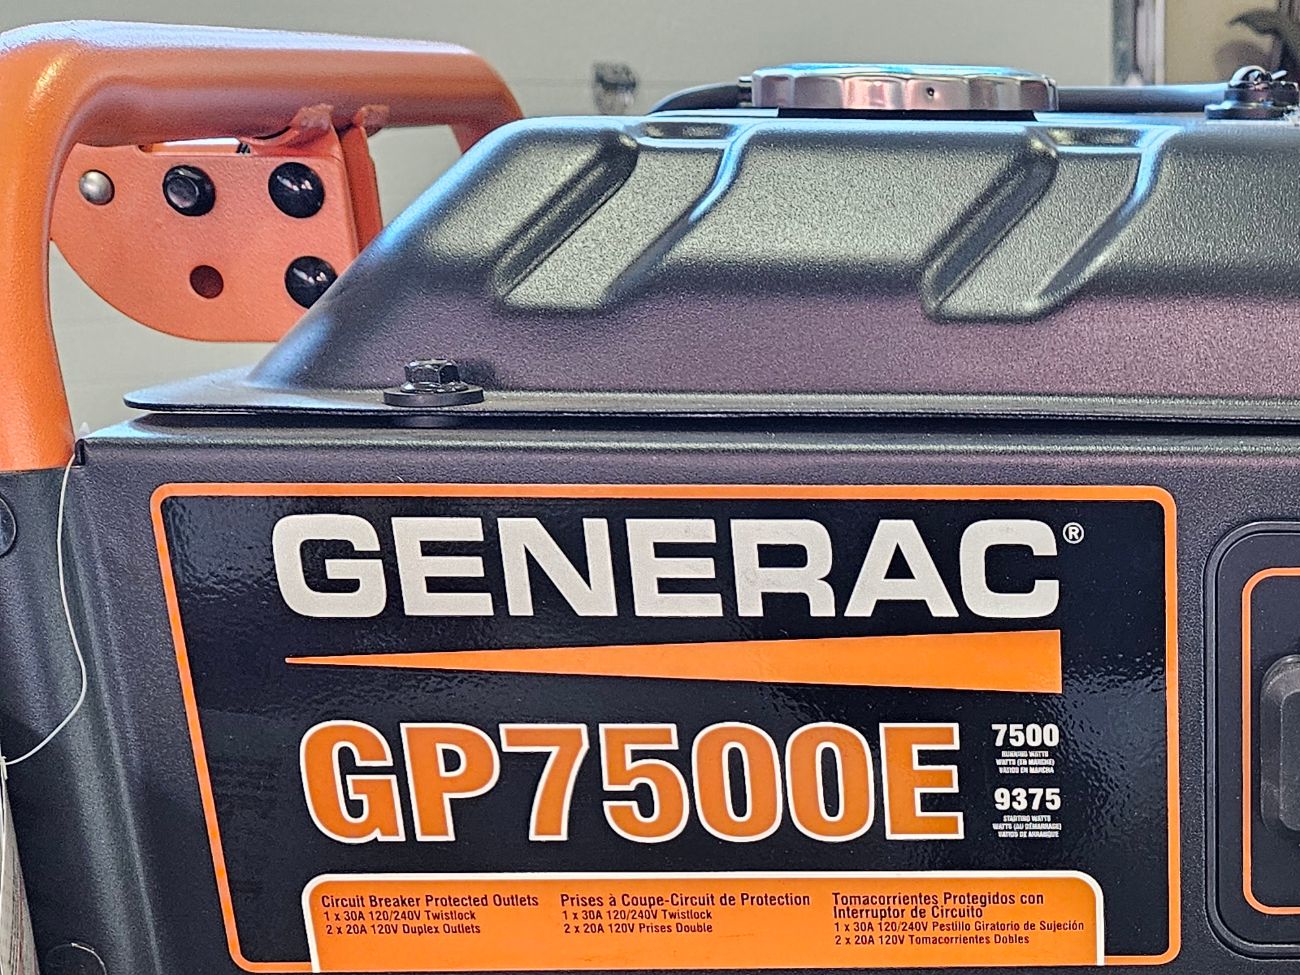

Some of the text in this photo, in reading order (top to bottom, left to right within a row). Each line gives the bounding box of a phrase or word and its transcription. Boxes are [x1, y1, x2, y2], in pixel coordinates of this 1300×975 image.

[991, 723, 1060, 747] 7500
[299, 720, 966, 844] GP7500E
[994, 787, 1061, 811] 9375
[321, 894, 539, 908] Circuit Breaker Protected Outlets
[560, 892, 810, 909] Prises à Coupe-Circuit de Protection
[832, 892, 1044, 907] Tomacorrientes Protegidos con
[324, 910, 476, 921] 1 x 30A 120/240V Twistlock
[562, 909, 712, 920] 1 x 30A 120/240V Twistlock
[833, 905, 983, 920] Interruptor de Circuito
[326, 923, 481, 936] 2 x 20A 120V Duplex Outlets
[564, 924, 571, 933] 2
[583, 923, 604, 933] 20A
[609, 923, 635, 933] 120V
[639, 923, 672, 933] Prises
[676, 923, 713, 933] Double
[834, 921, 1084, 932] 1 x 30A 120/240V Pestillo Giratorio de Sujeción
[835, 934, 1029, 945] 2 x 20A 120V Tomacorrientes Dobles
